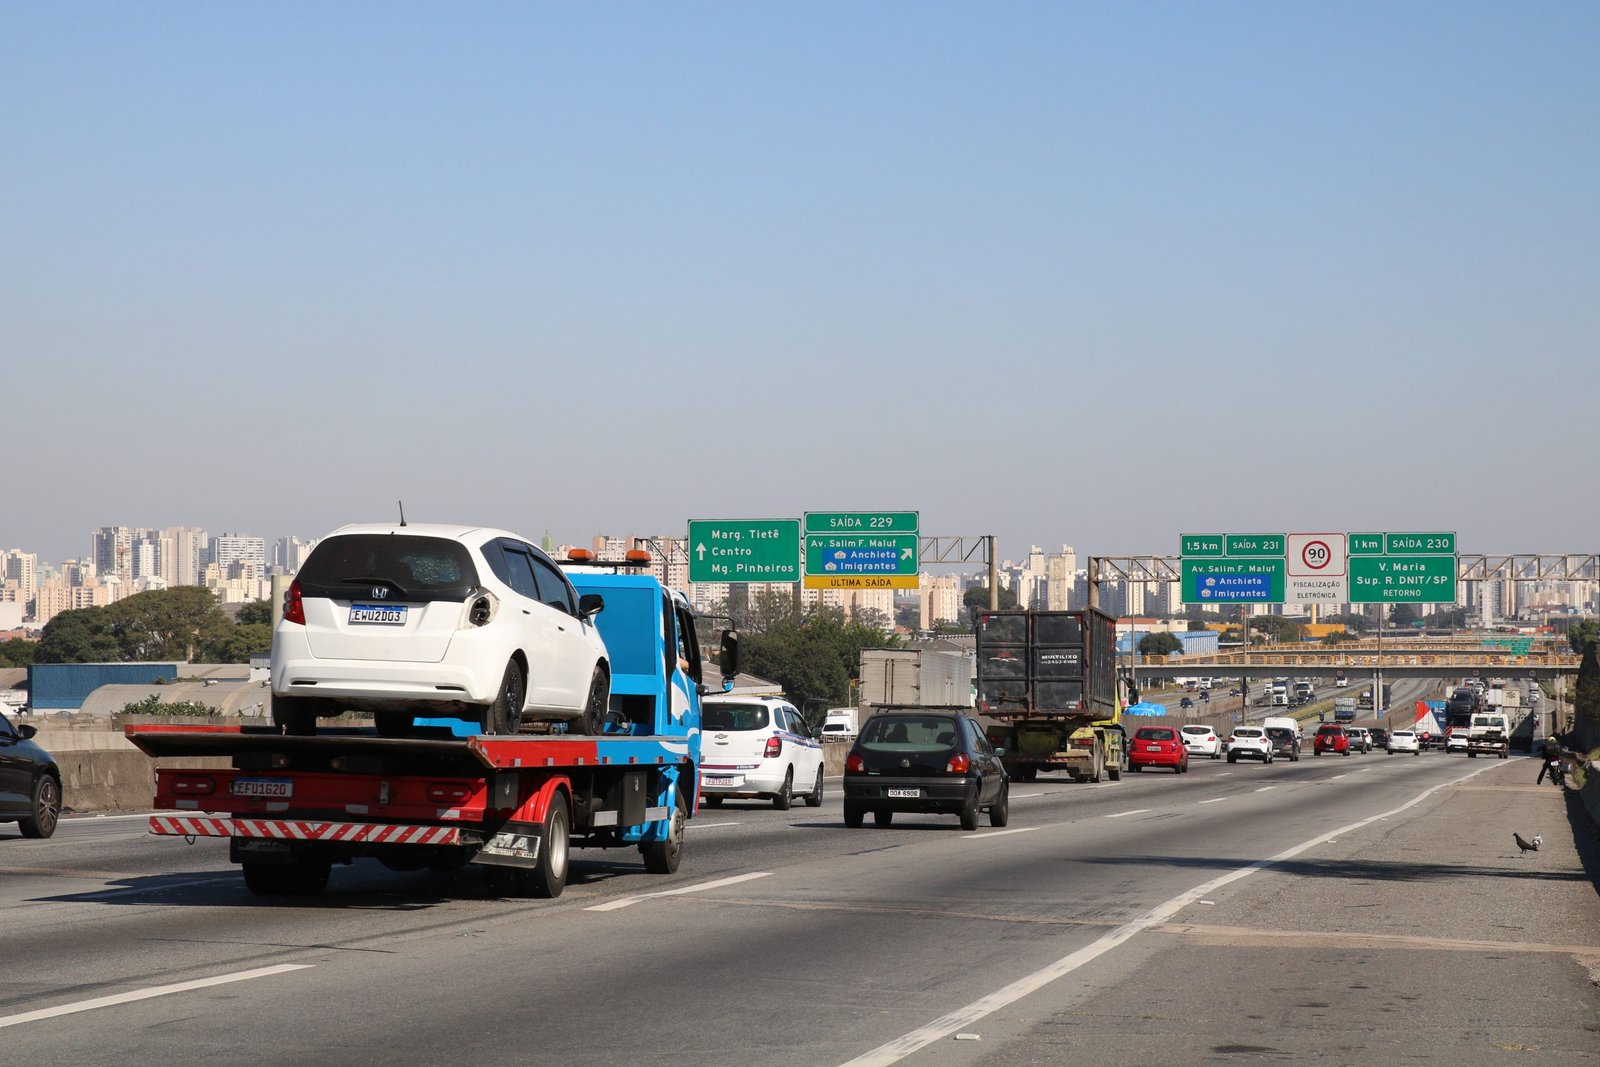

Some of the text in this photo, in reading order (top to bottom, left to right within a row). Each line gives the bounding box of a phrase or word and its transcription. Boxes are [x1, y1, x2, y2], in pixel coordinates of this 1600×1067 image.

[831, 515, 892, 527] SAÍDA 229
[712, 529, 779, 541] Marg. Tietê
[1203, 542, 1217, 550] km
[1233, 539, 1278, 549] SAÍDA 231
[1355, 540, 1358, 548] 1
[1393, 537, 1449, 548] SAÍDA 230
[712, 547, 751, 555] Centro
[1308, 548, 1326, 560] 90
[712, 564, 793, 575] Mg. Pinheiros
[841, 563, 896, 571] Imigrantes
[1379, 563, 1425, 571] V. Maria
[831, 576, 891, 586] ÚLTIMA SAÍDA
[1357, 576, 1380, 586] Sup.
[1386, 576, 1394, 584] R.
[1215, 590, 1266, 598] Imigrantes
[1383, 589, 1421, 597] RETORNO
